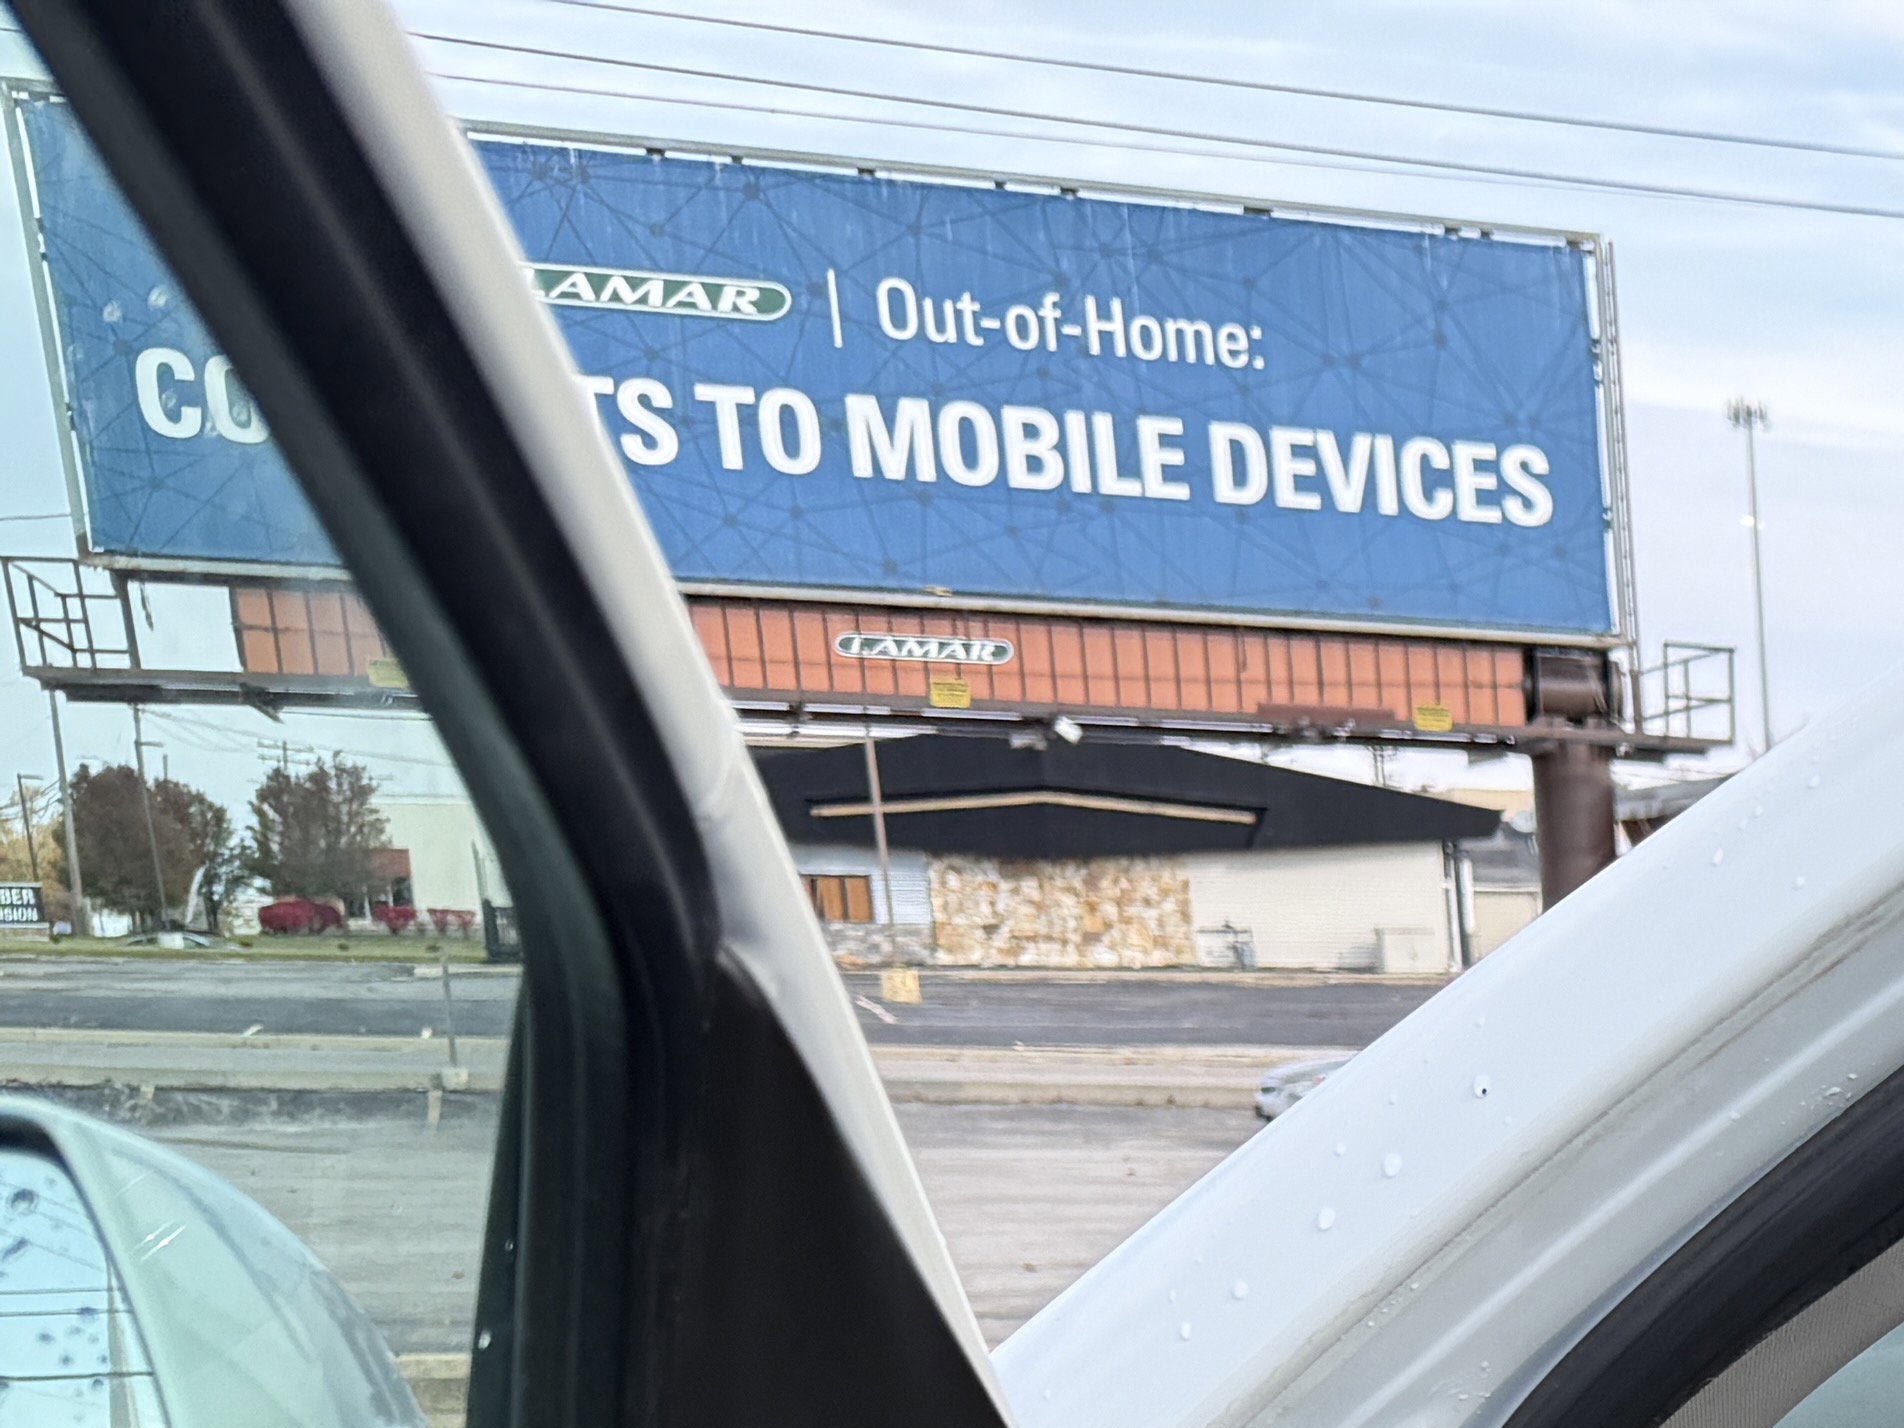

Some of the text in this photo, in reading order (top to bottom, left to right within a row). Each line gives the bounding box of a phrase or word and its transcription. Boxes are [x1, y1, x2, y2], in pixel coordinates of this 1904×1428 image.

[876, 276, 1265, 370] Out-of-Home:
[694, 382, 822, 475] TO
[844, 393, 1191, 500] MOBILE
[1208, 420, 1554, 527] DEVICES
[849, 636, 996, 662] LAMAR
